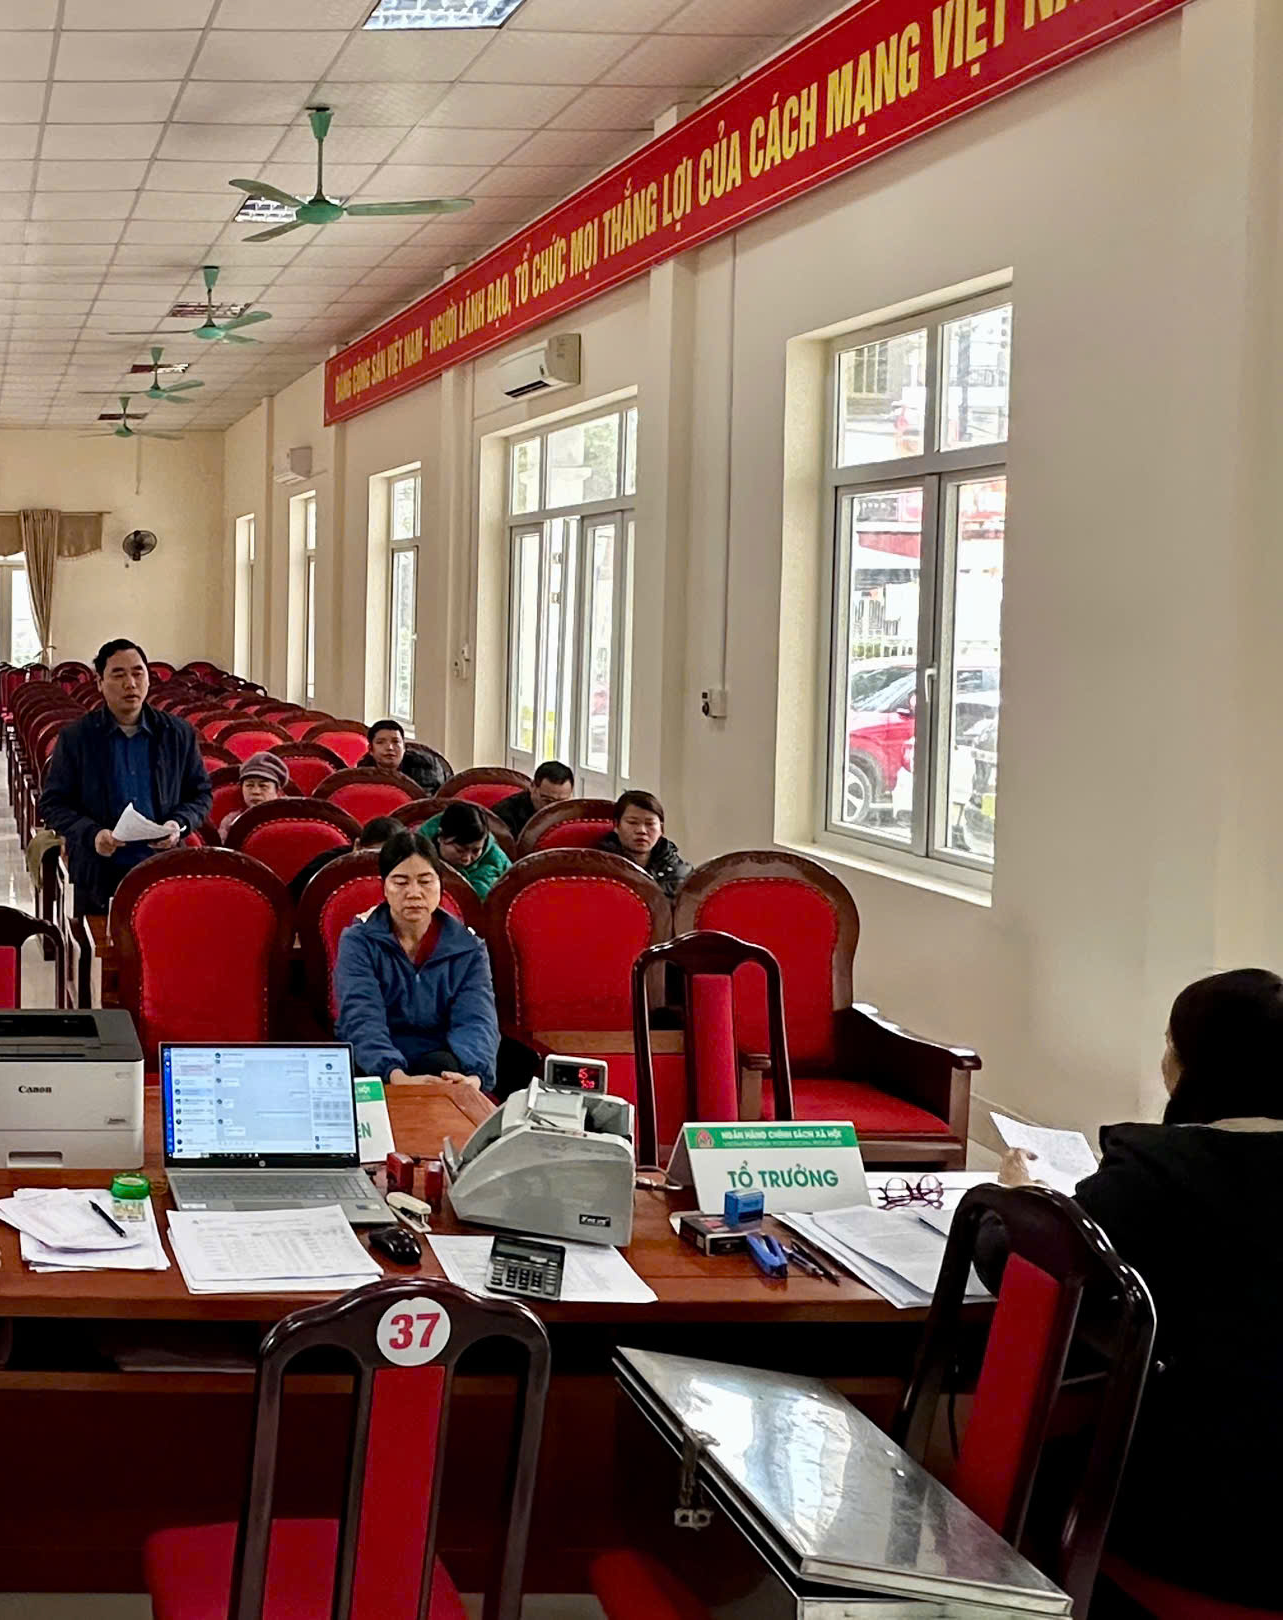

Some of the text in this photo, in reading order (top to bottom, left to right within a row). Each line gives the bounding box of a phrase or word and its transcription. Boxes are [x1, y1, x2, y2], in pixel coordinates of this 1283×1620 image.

[459, 289, 485, 339] LÃNH
[487, 272, 512, 328] ĐẠO,
[515, 242, 529, 308] TỔ
[532, 233, 566, 298] CHỨC
[570, 217, 599, 280] MỌI
[603, 177, 657, 260] THẮNG
[662, 156, 693, 232] LỢI
[698, 120, 742, 206] CỦA
[749, 82, 818, 178] CÁCH
[825, 22, 921, 137] MẠNG
[18, 1085, 52, 1094] Canon
[726, 1160, 839, 1188] TỔ TRƯỞNG
[388, 1312, 441, 1350] 37
